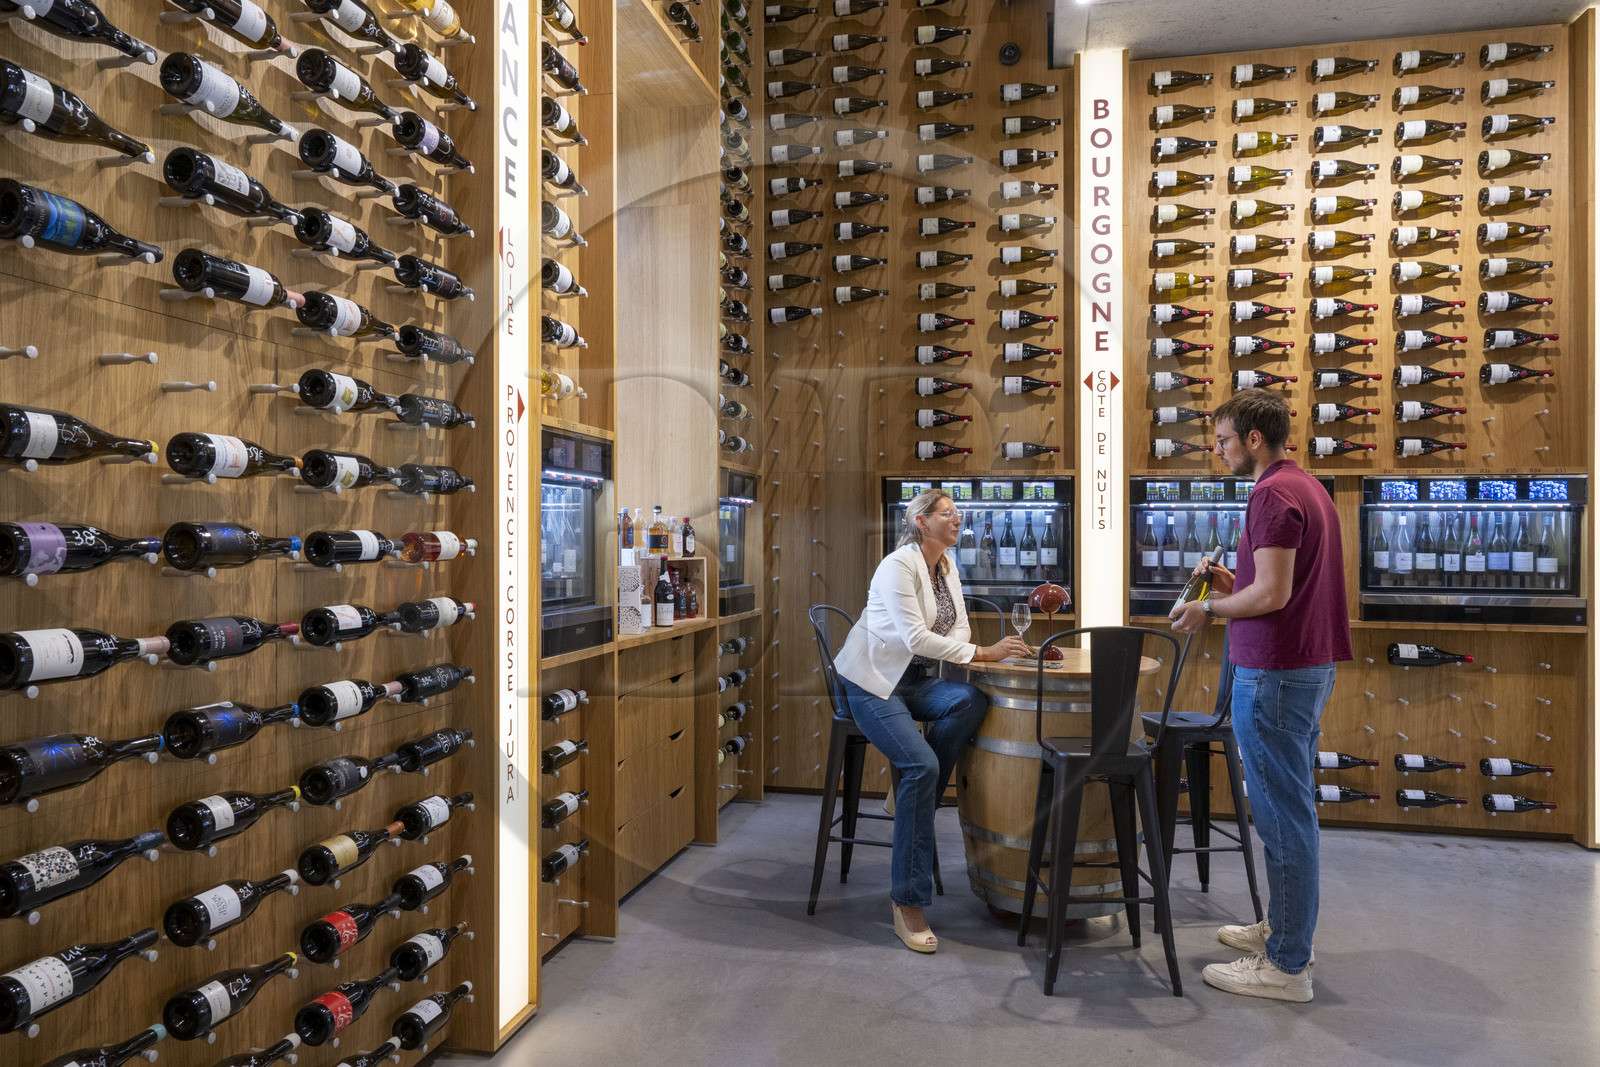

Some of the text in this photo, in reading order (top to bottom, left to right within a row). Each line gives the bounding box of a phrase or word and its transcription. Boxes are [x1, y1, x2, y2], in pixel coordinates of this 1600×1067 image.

[506, 228, 516, 336] LOIRE
[1090, 98, 1113, 352] BOURGOGNE
[1097, 369, 1107, 530] CÔTE DE NUITS
[72, 526, 100, 547] 38€
[505, 384, 515, 805] PROVENCE CORSE JURA
[229, 973, 252, 999] 42€
